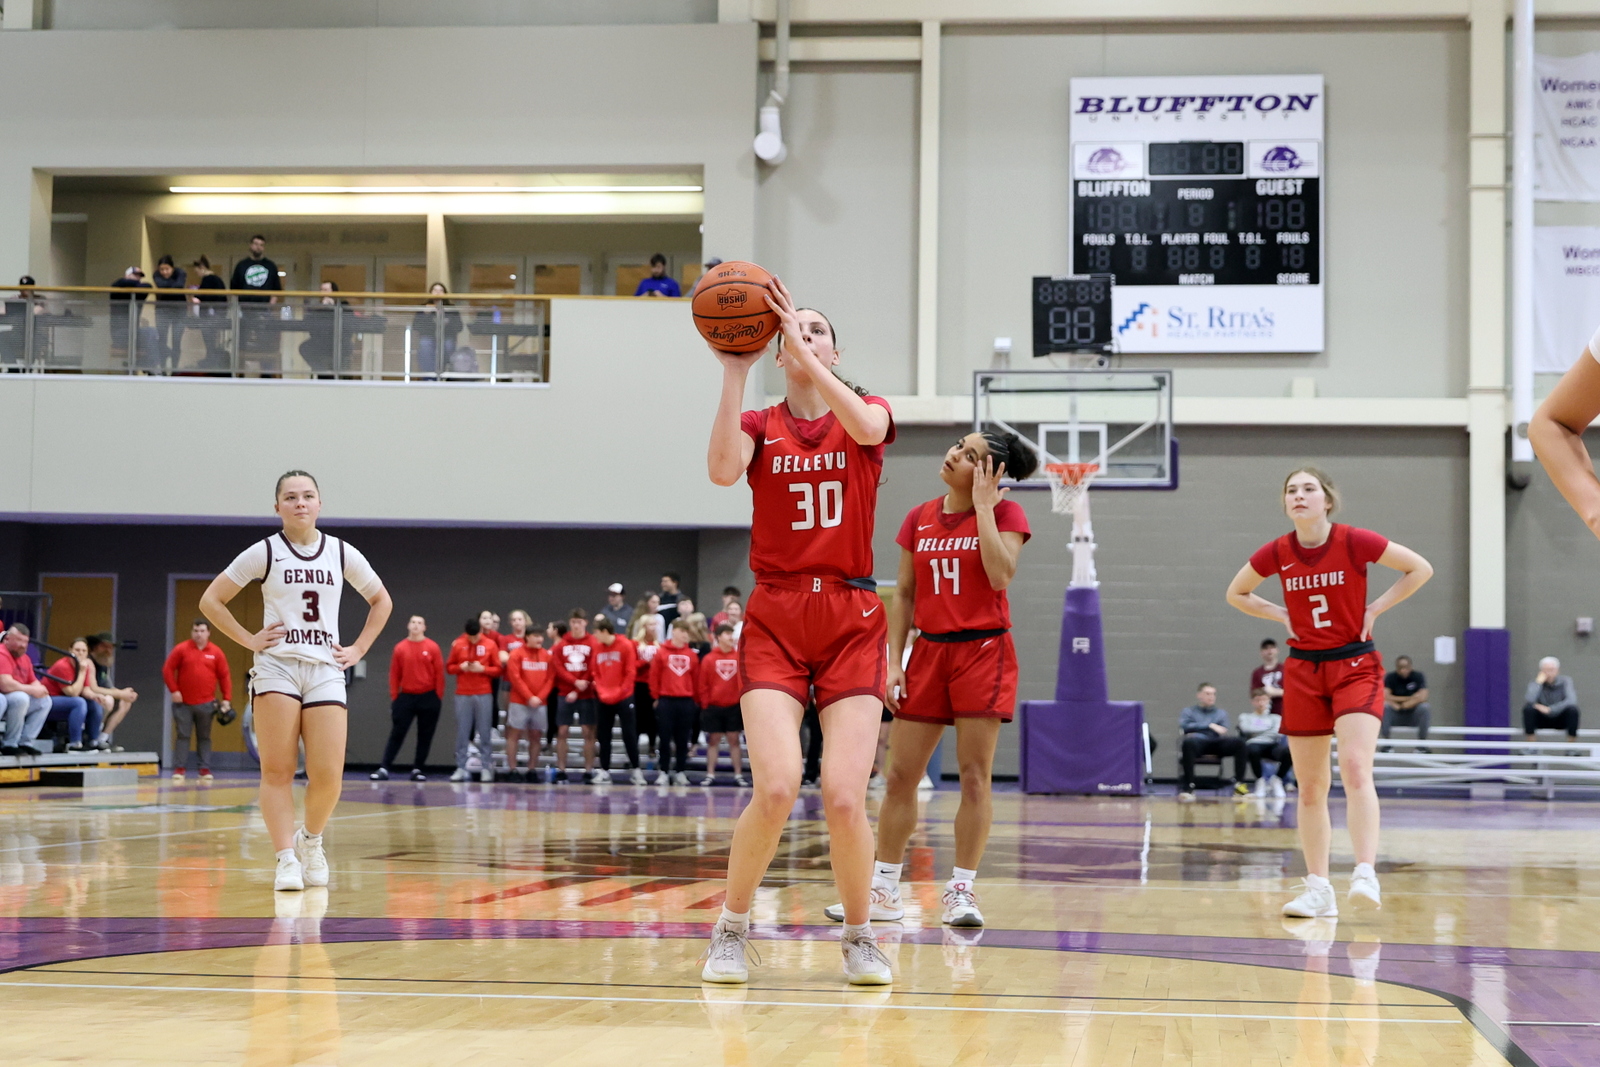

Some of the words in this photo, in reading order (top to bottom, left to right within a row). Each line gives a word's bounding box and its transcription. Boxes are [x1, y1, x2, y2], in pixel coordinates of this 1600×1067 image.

[1075, 94, 1319, 114] BLUFFTON
[1089, 114, 1290, 122] UNIVERSITY
[1078, 180, 1151, 197] BLUFFTON
[1177, 187, 1214, 200] PERIOD
[1256, 179, 1305, 196] GUEST
[1083, 232, 1116, 246] FOULS
[1161, 233, 1200, 245] PLAYER
[1203, 233, 1229, 245] FOUL
[1276, 232, 1310, 245] FOULS
[1178, 274, 1215, 285] MATCH
[1276, 272, 1310, 285] SCORE
[718, 294, 746, 304] OHSAA
[707, 320, 764, 343] Rawlings
[788, 480, 844, 532] 30
[916, 536, 979, 553] BELLEVUE
[284, 569, 335, 586] GENOA
[812, 577, 823, 593] B
[929, 557, 961, 596] 14
[1285, 570, 1345, 592] BELLEVUE
[301, 590, 320, 622] 3
[1308, 594, 1332, 629] 2
